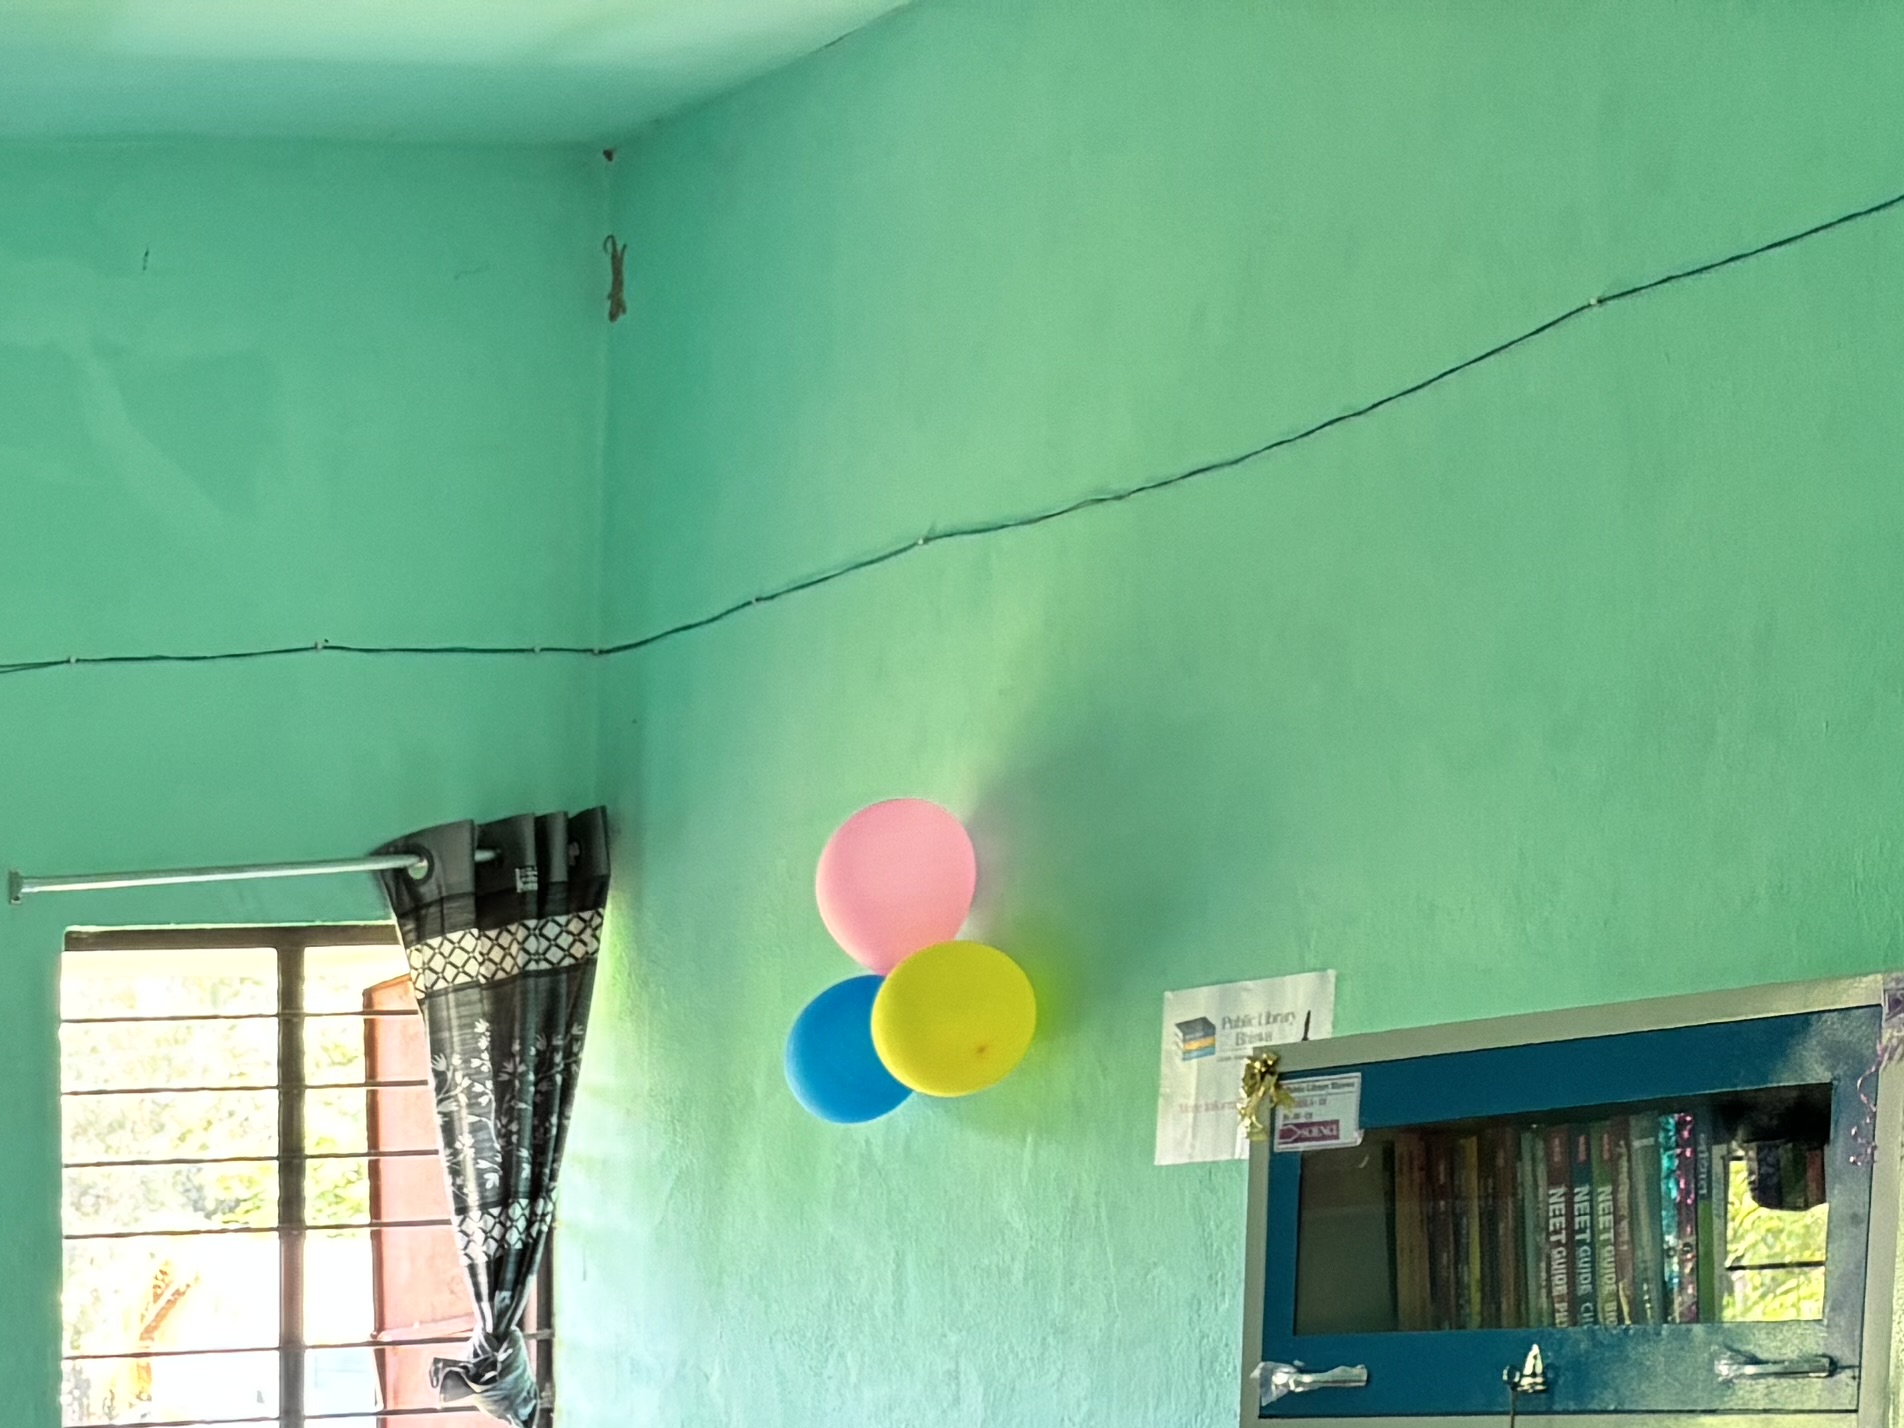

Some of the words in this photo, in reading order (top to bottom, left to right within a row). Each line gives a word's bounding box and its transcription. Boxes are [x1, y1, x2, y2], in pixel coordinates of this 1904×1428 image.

[1549, 1184, 1566, 1243] NEET
[1574, 1184, 1591, 1242] NEET
[1597, 1185, 1614, 1243] NEET
[1552, 1247, 1568, 1296] GUIDE
[1576, 1246, 1592, 1296] GUIDE
[1602, 1245, 1616, 1294] GUIDE
